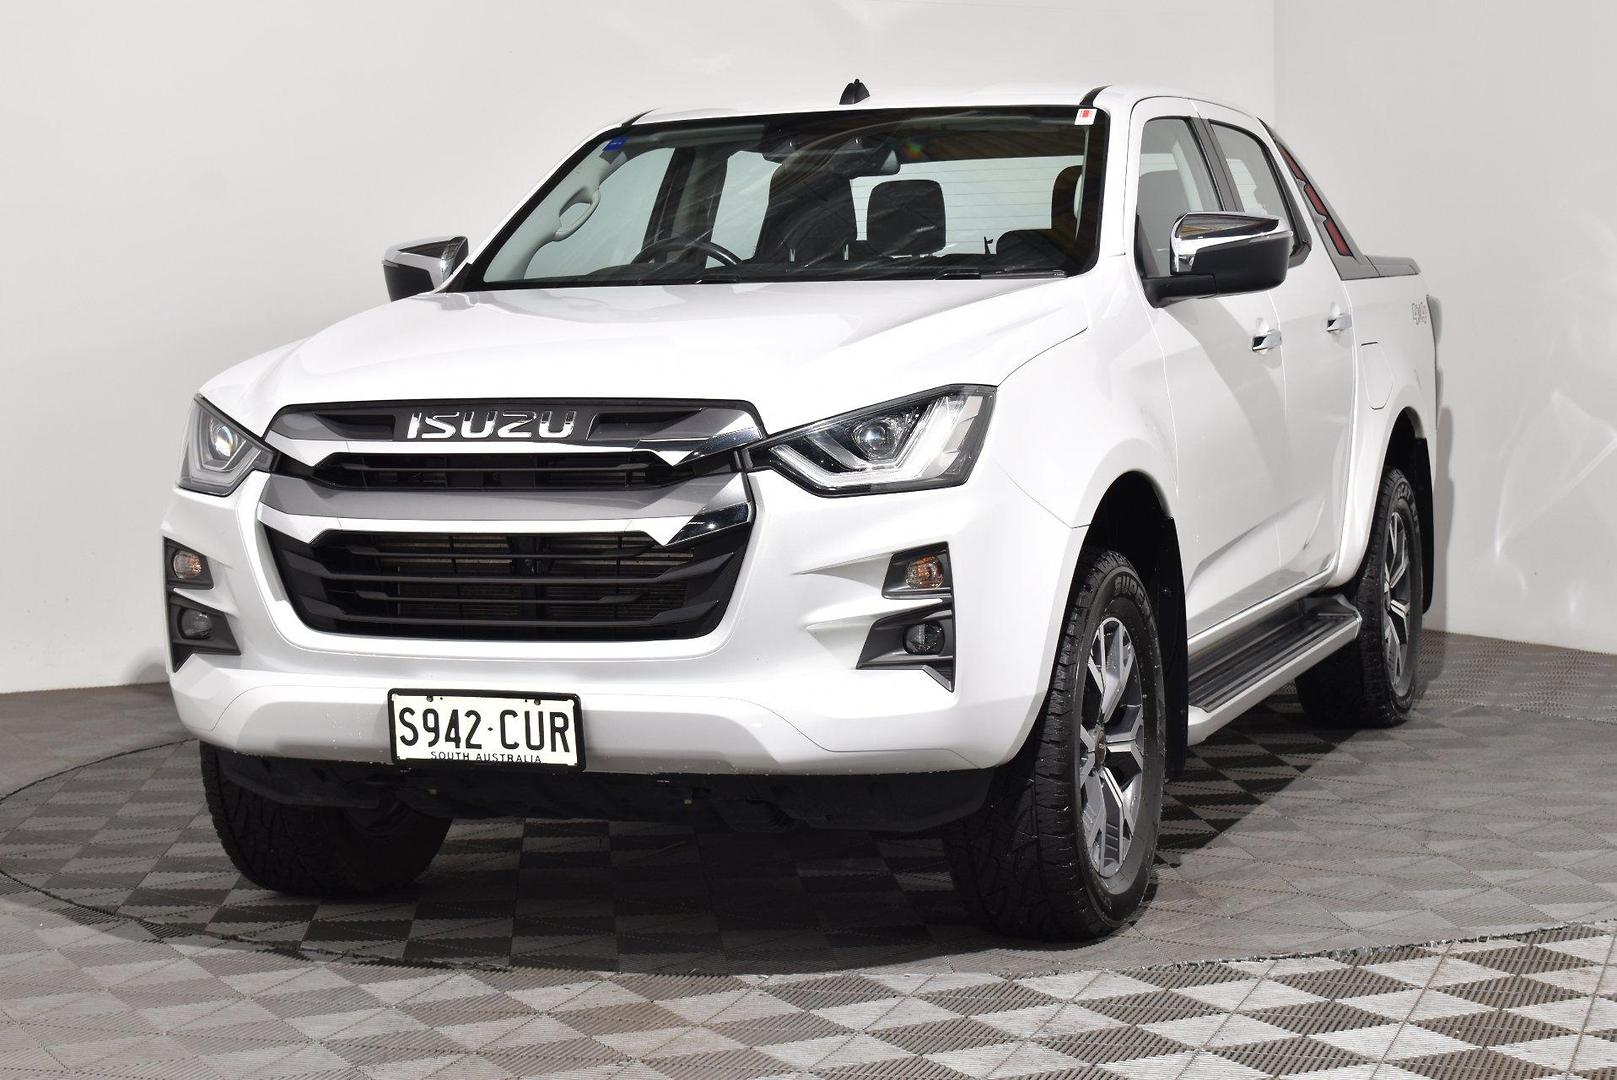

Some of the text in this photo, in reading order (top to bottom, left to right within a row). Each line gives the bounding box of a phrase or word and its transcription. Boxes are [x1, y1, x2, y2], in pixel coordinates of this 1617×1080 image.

[407, 411, 577, 439] ISUZU
[430, 750, 542, 763] SOUTH AUSTRALIA
